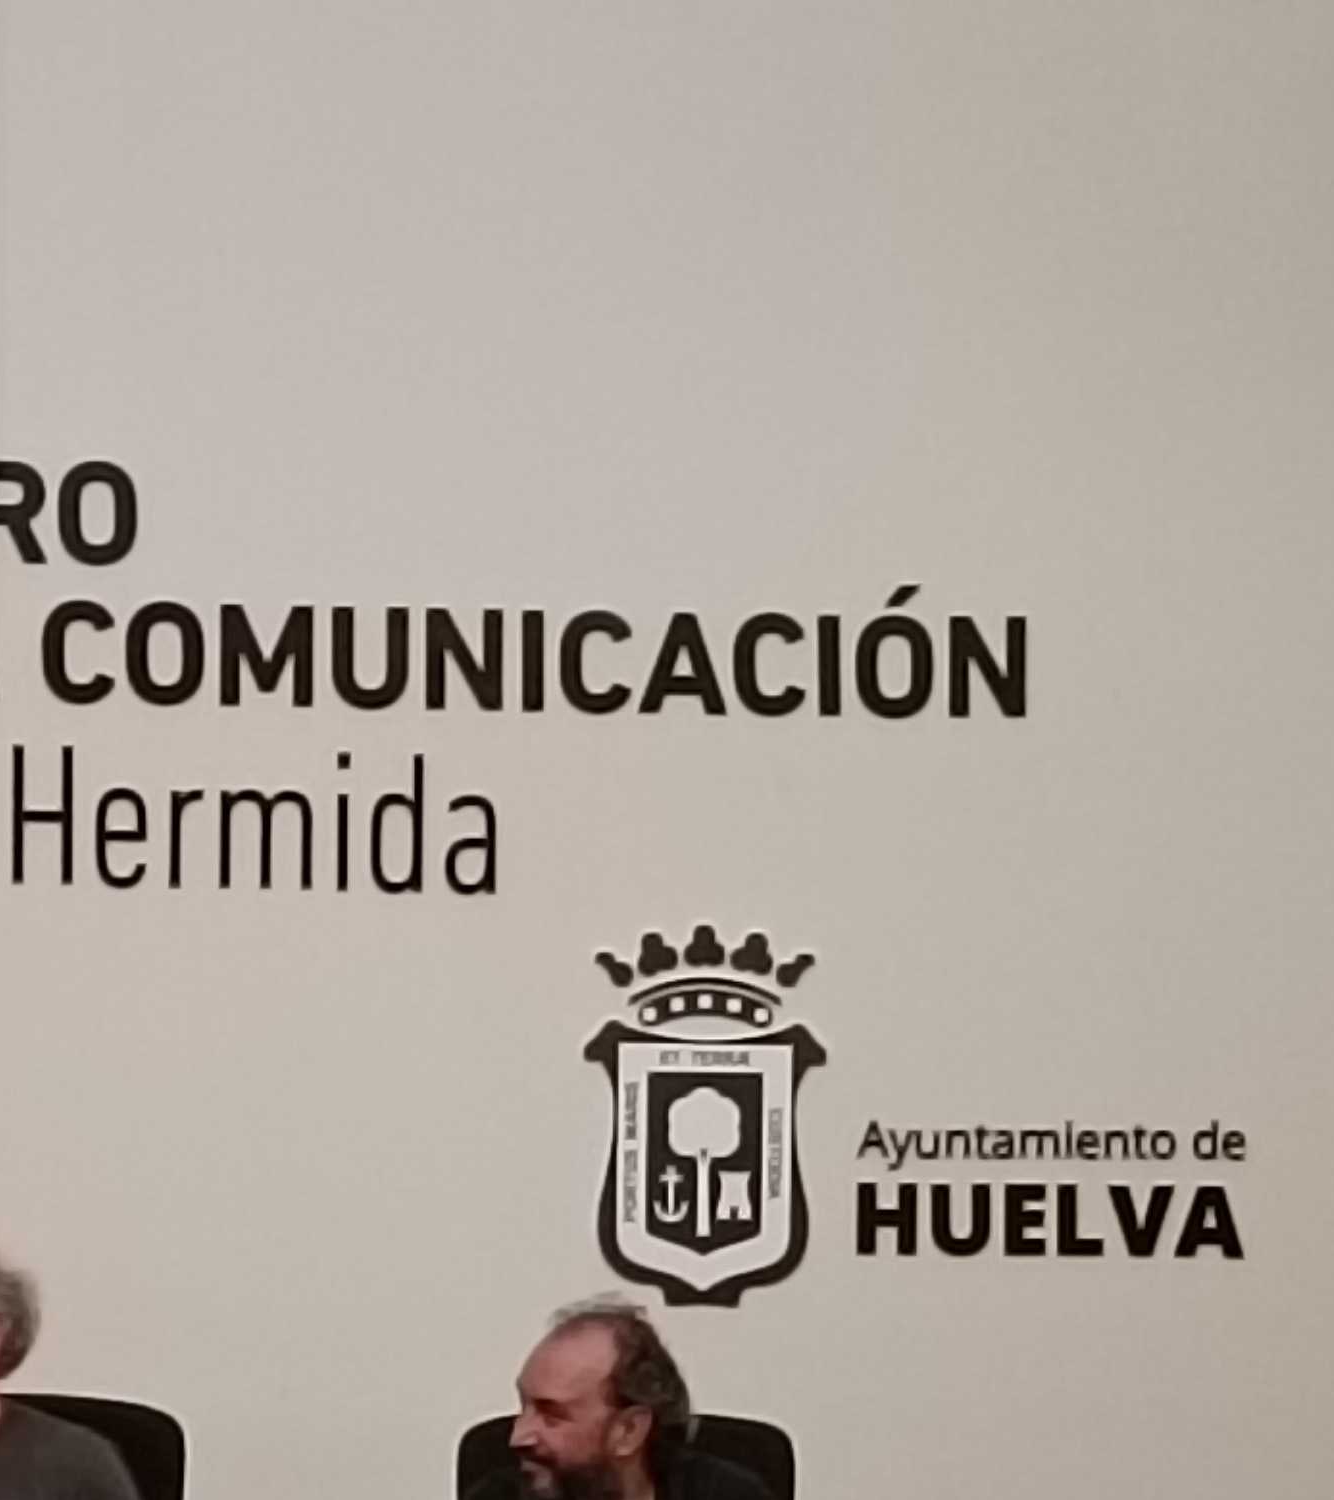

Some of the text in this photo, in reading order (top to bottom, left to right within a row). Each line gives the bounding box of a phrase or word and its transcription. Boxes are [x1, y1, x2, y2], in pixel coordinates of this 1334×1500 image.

[41, 584, 1027, 720] COMUNICACIÓN
[11, 744, 497, 896] Hermida
[857, 1120, 1248, 1172] Ayuntamiento de
[856, 1182, 1245, 1261] HUELVA
